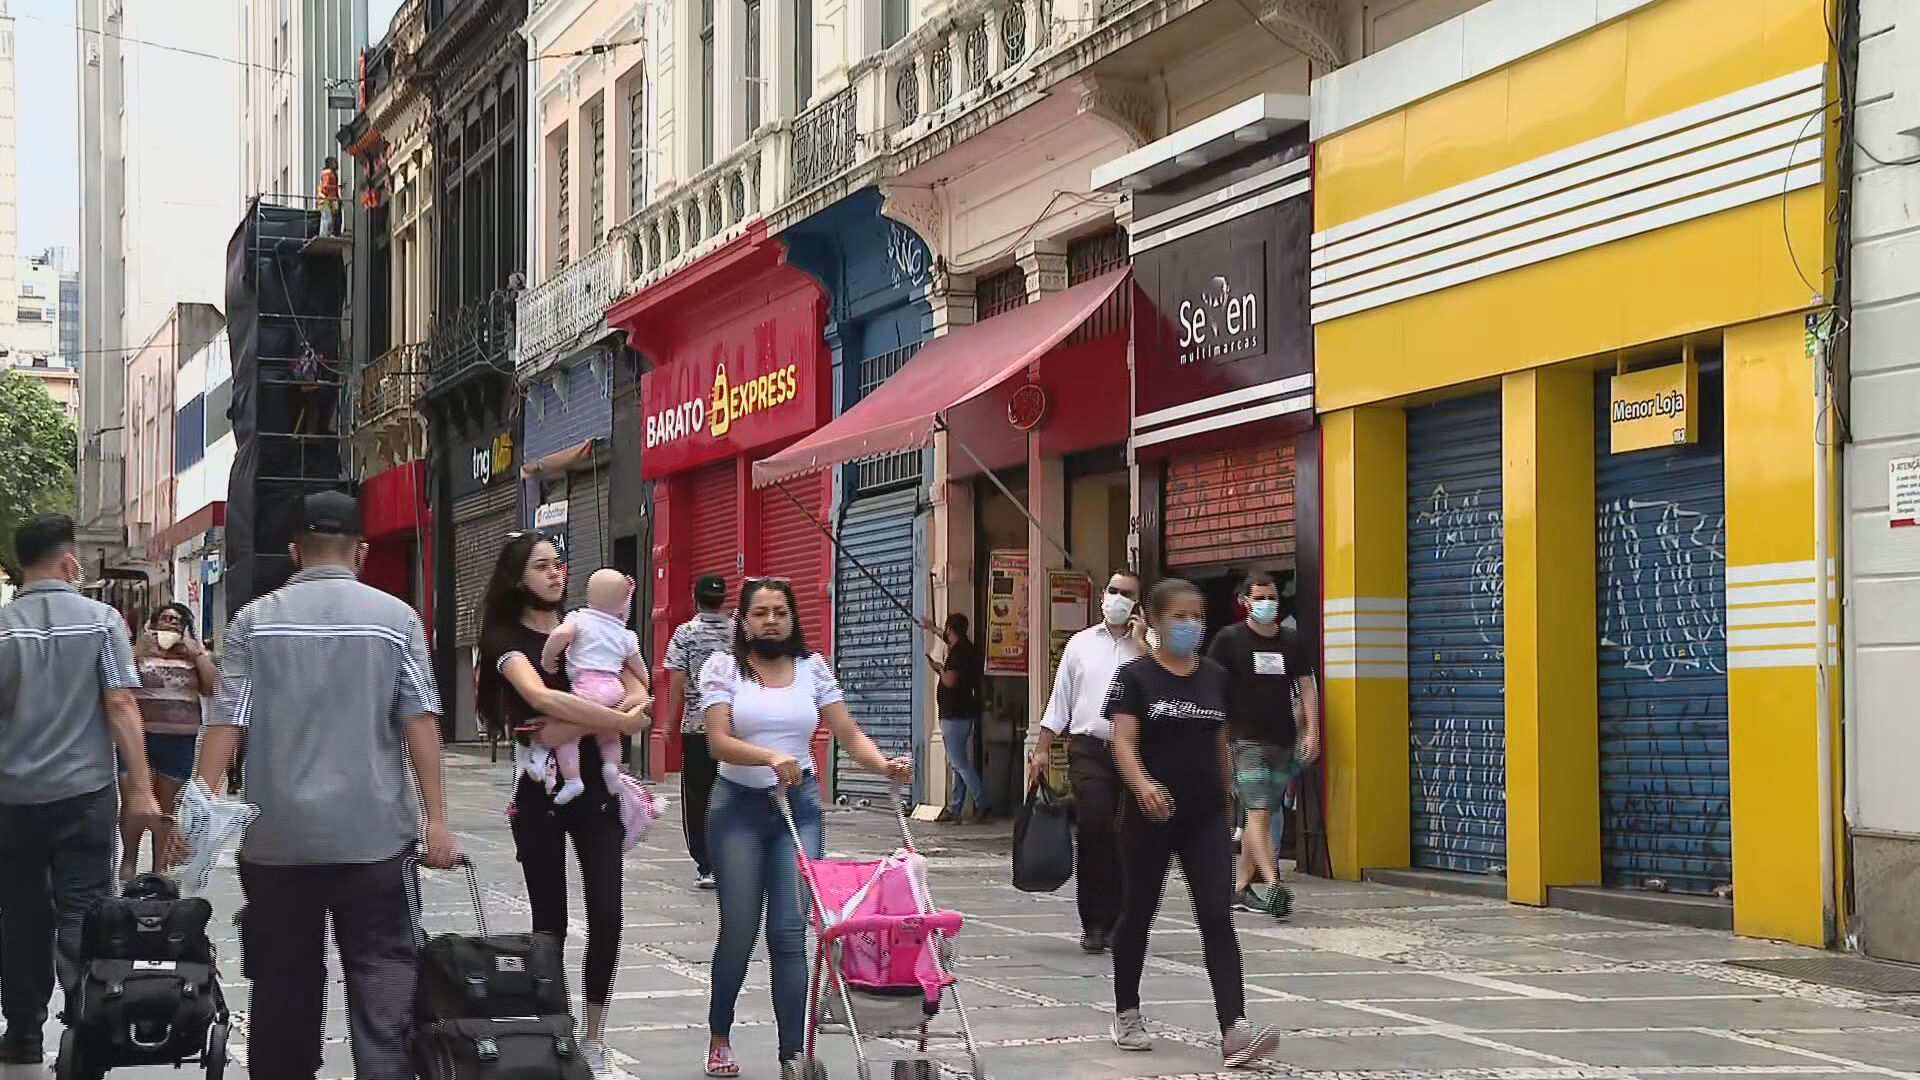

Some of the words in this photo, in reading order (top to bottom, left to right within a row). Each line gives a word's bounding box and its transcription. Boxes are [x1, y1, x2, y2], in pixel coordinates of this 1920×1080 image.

[1179, 292, 1257, 348] Seen
[1180, 335, 1257, 365] multimarcas
[646, 398, 704, 448] BARATO
[730, 364, 797, 421] EXPRESS
[1613, 399, 1654, 422] Menor
[1656, 390, 1684, 418] Loja
[472, 447, 490, 484] tng
